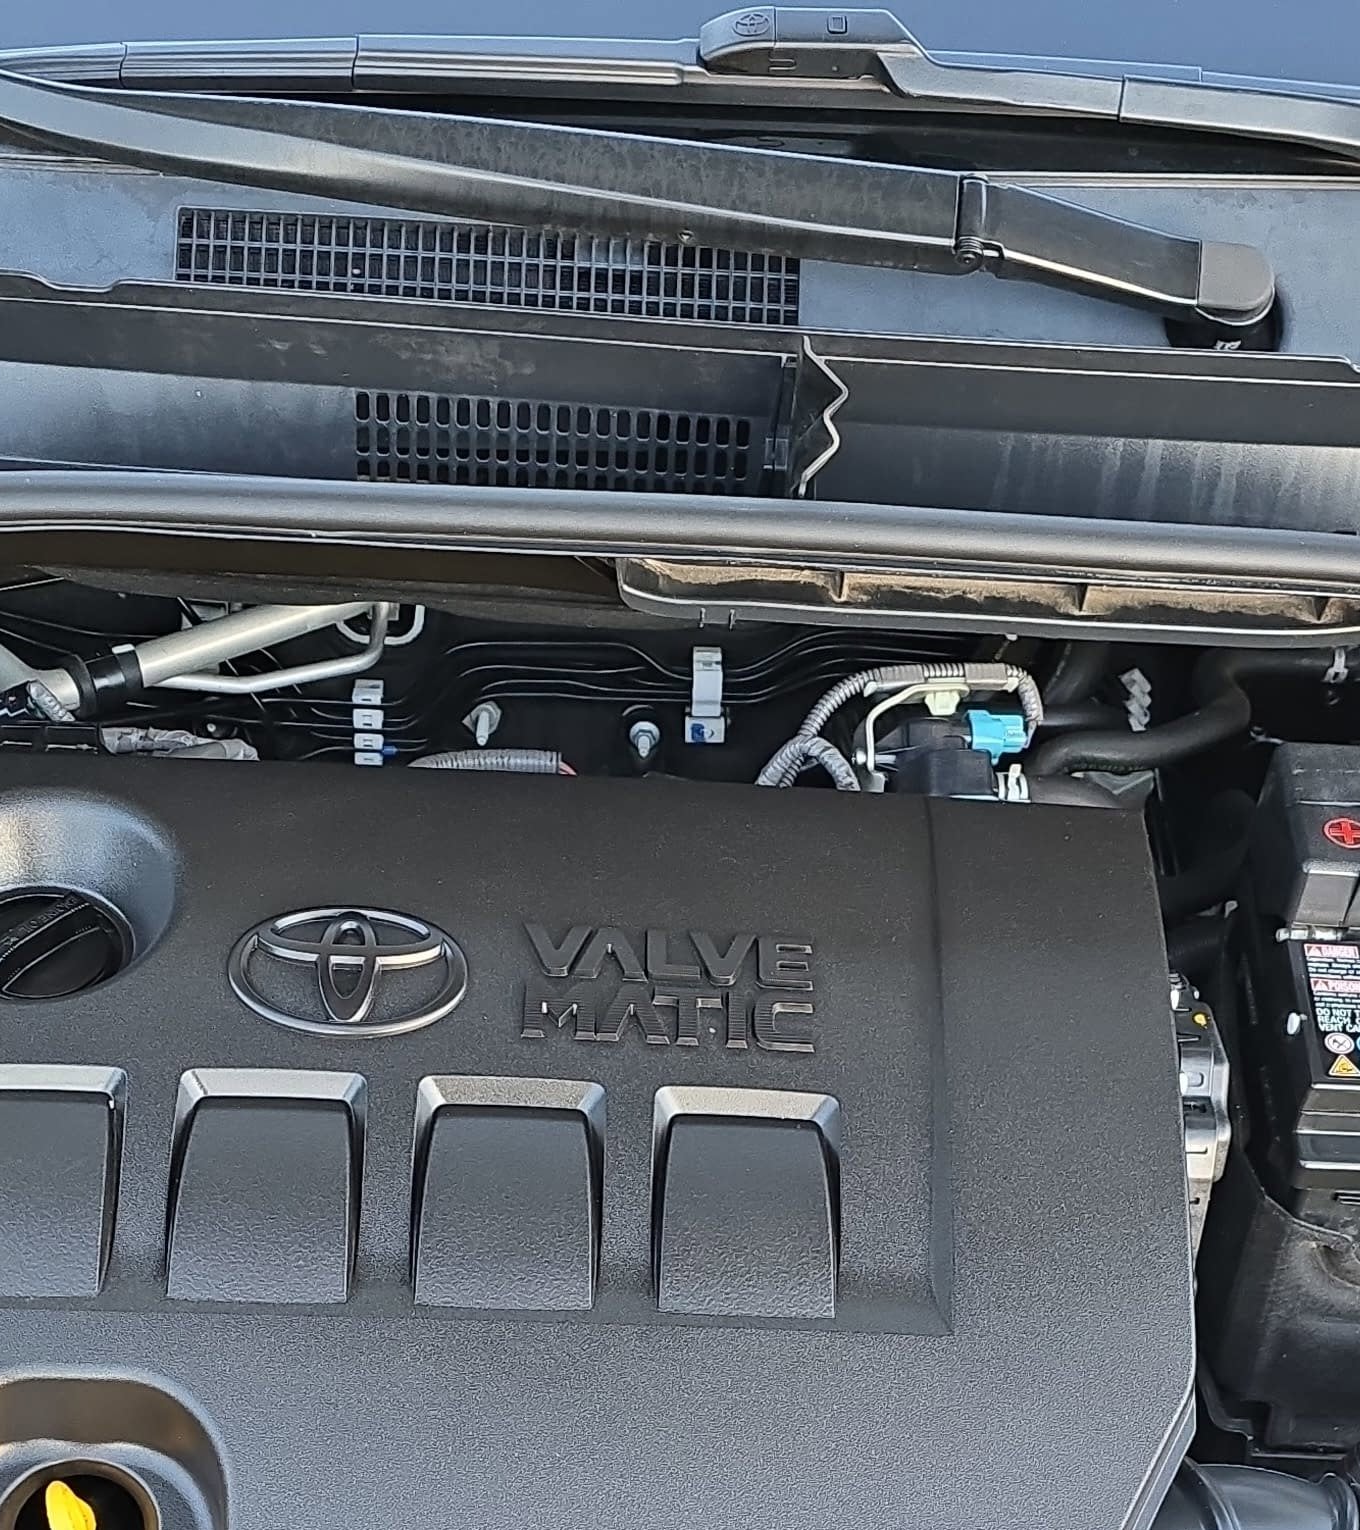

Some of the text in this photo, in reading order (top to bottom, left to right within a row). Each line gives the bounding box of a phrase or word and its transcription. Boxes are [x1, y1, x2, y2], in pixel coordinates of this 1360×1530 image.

[522, 921, 814, 990] VALVE
[1316, 1008, 1330, 1016] DO
[1332, 1009, 1352, 1017] NOT
[521, 984, 815, 1052] MATIC
[1318, 1015, 1351, 1025] REACH
[1319, 1022, 1344, 1032] VENT
